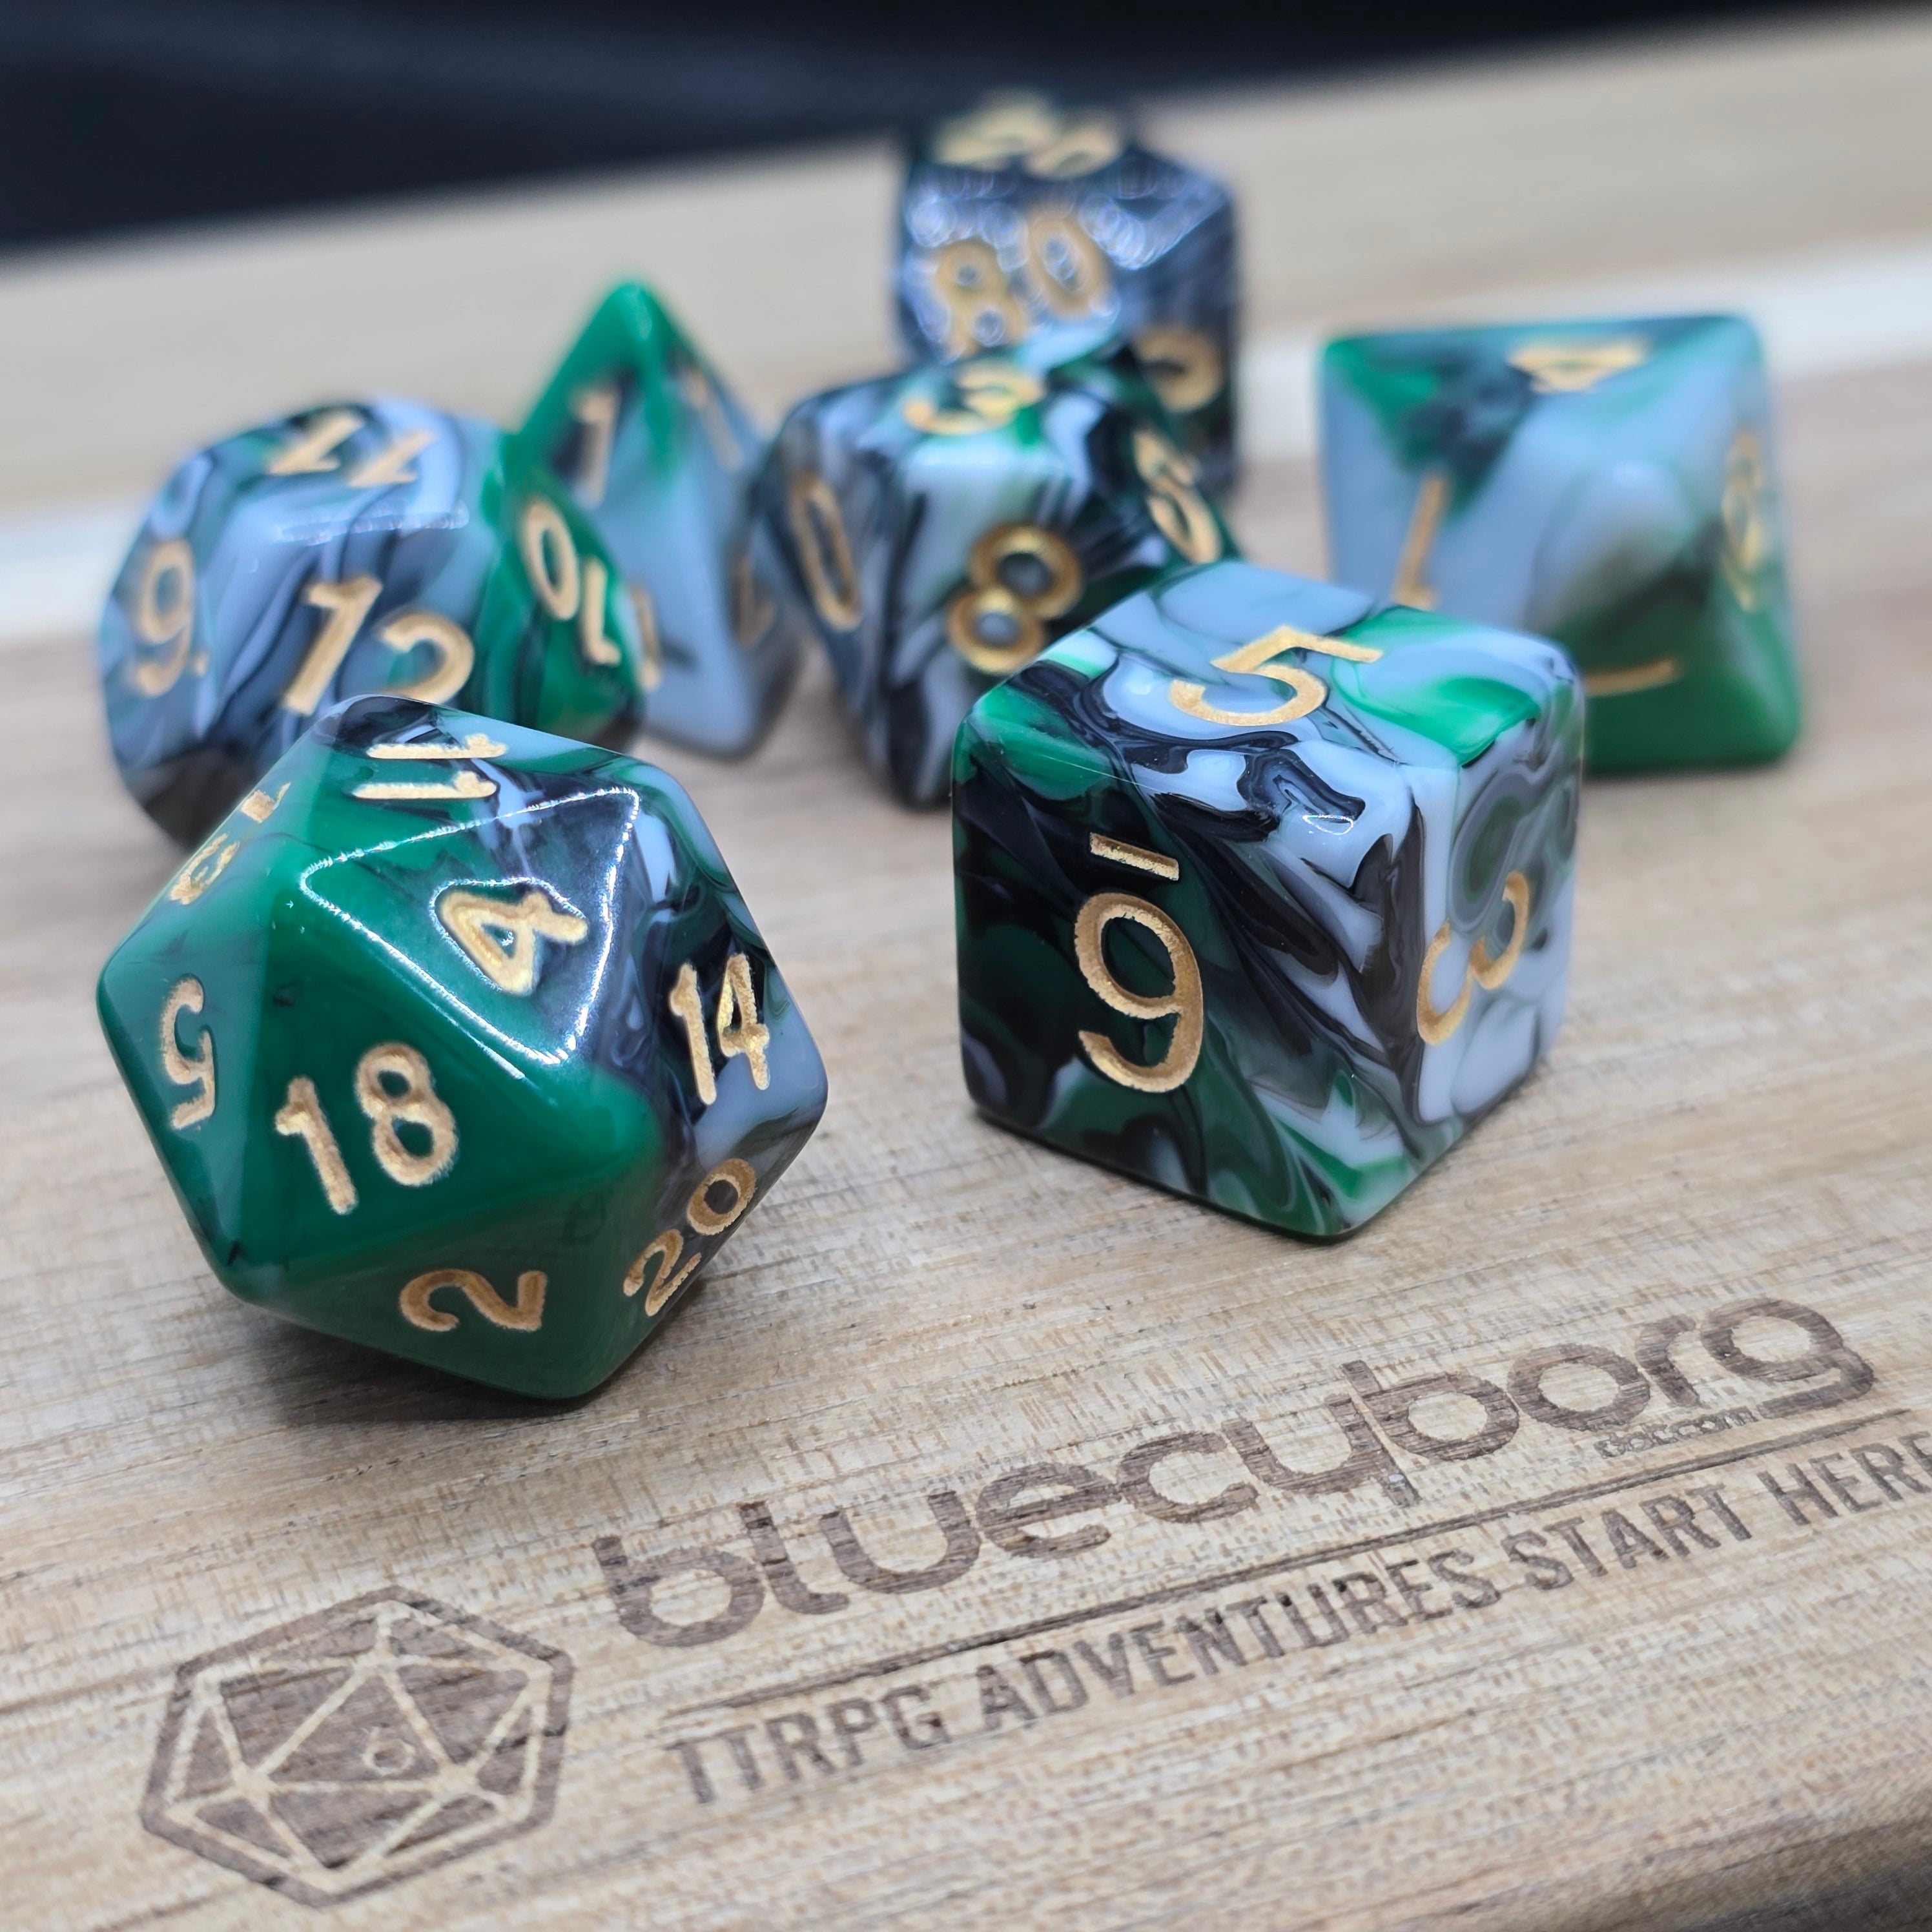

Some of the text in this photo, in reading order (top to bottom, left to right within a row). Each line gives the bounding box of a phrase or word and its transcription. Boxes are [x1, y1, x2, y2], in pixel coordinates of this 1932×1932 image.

[904, 360, 1043, 435] 3
[788, 473, 861, 631] 0
[947, 522, 1084, 675] 8
[1169, 625, 1384, 727] 5
[351, 733, 508, 801] 11
[442, 891, 588, 996] 4
[1415, 870, 1530, 1046] 3
[670, 954, 770, 1105] 14
[275, 1040, 460, 1215] 18
[399, 1268, 547, 1332] 2
[622, 1157, 758, 1317] 20
[591, 1297, 1878, 1648] bluecyborg
[664, 1683, 952, 1804] TTRPG
[975, 1550, 1501, 1731] ADVENTURES
[1501, 1483, 1752, 1590] START
